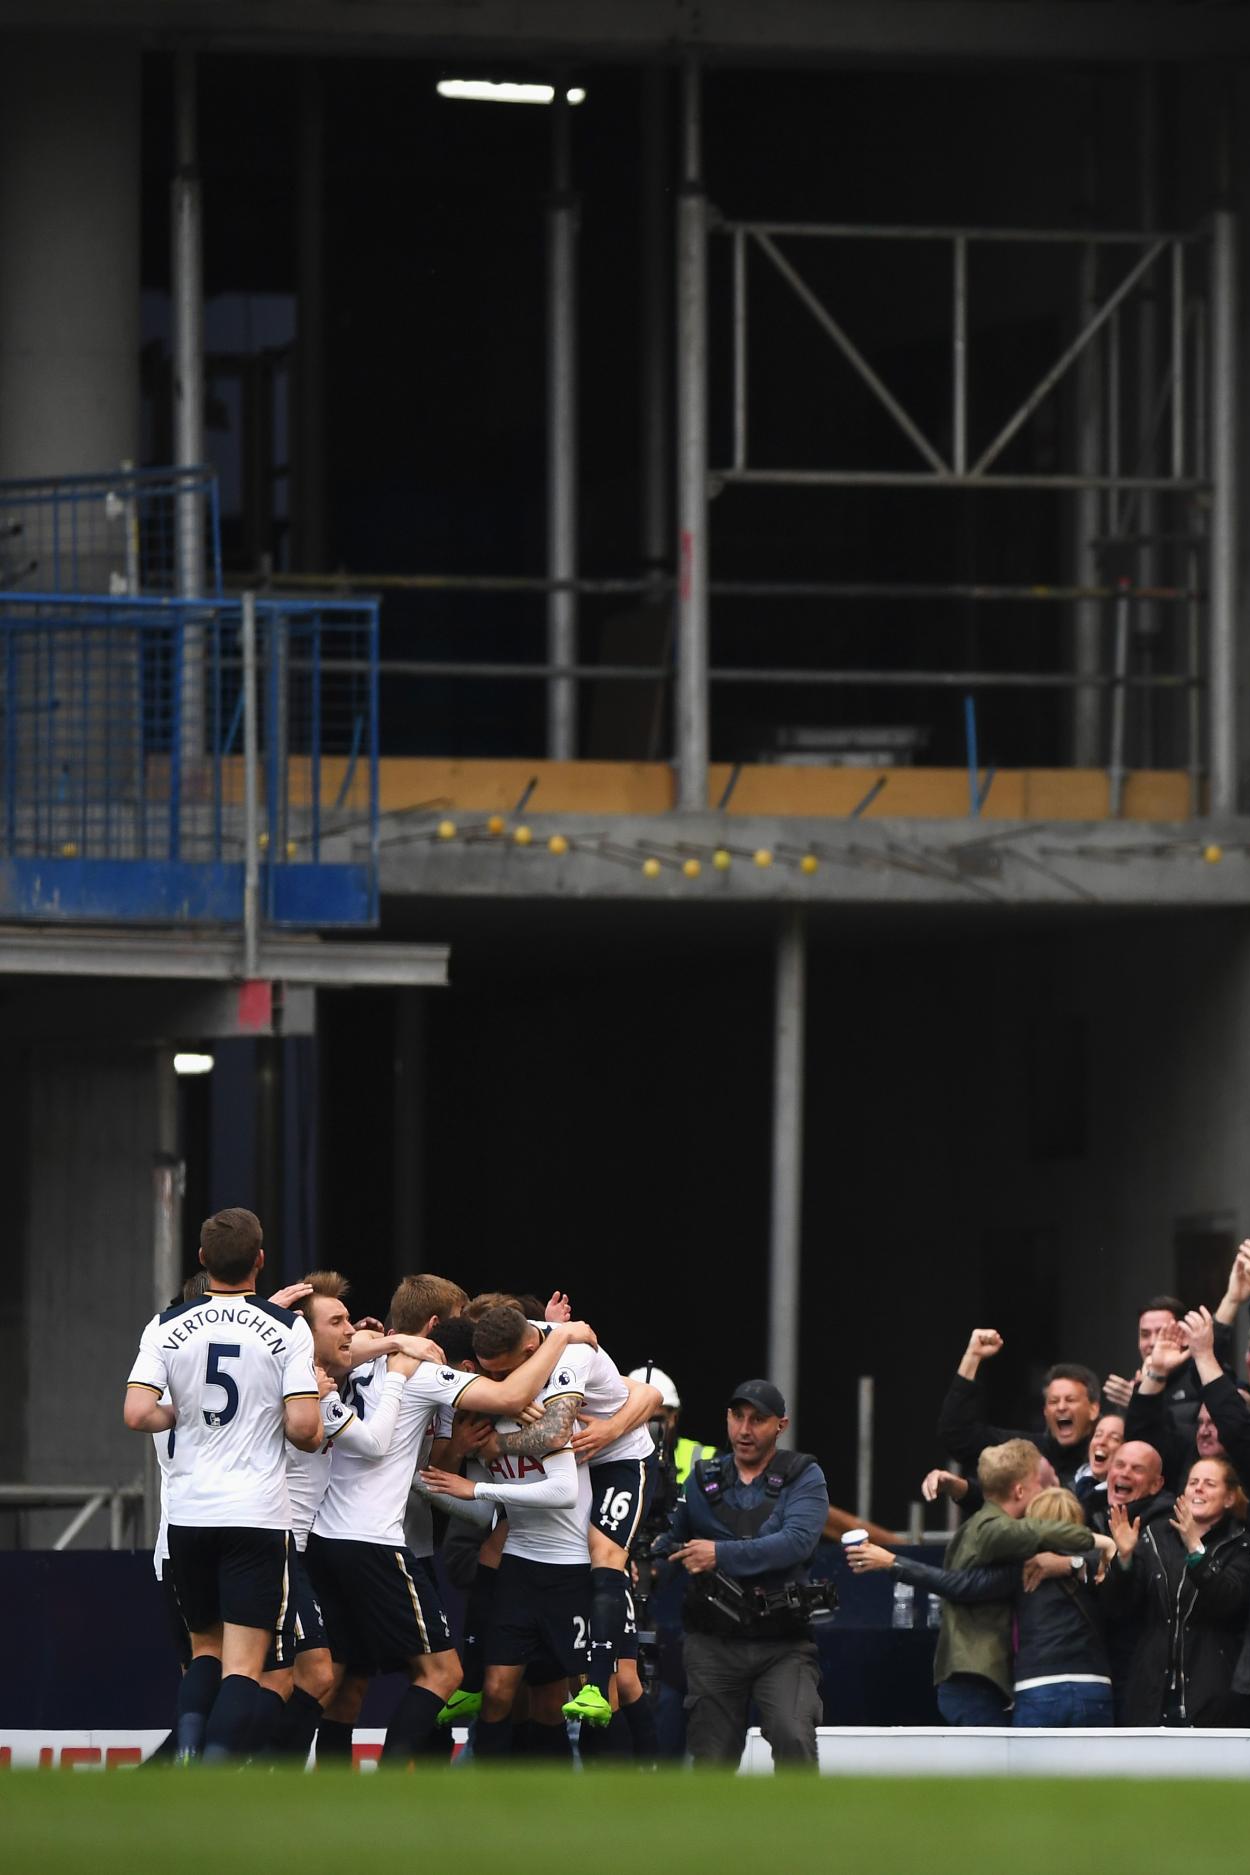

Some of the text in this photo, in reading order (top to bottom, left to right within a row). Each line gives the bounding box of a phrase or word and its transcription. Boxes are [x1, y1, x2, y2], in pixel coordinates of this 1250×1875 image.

[163, 1309, 286, 1356] VERTONGHEN
[203, 1342, 241, 1428] 5
[600, 1487, 632, 1521] 16
[573, 1616, 591, 1649] 2
